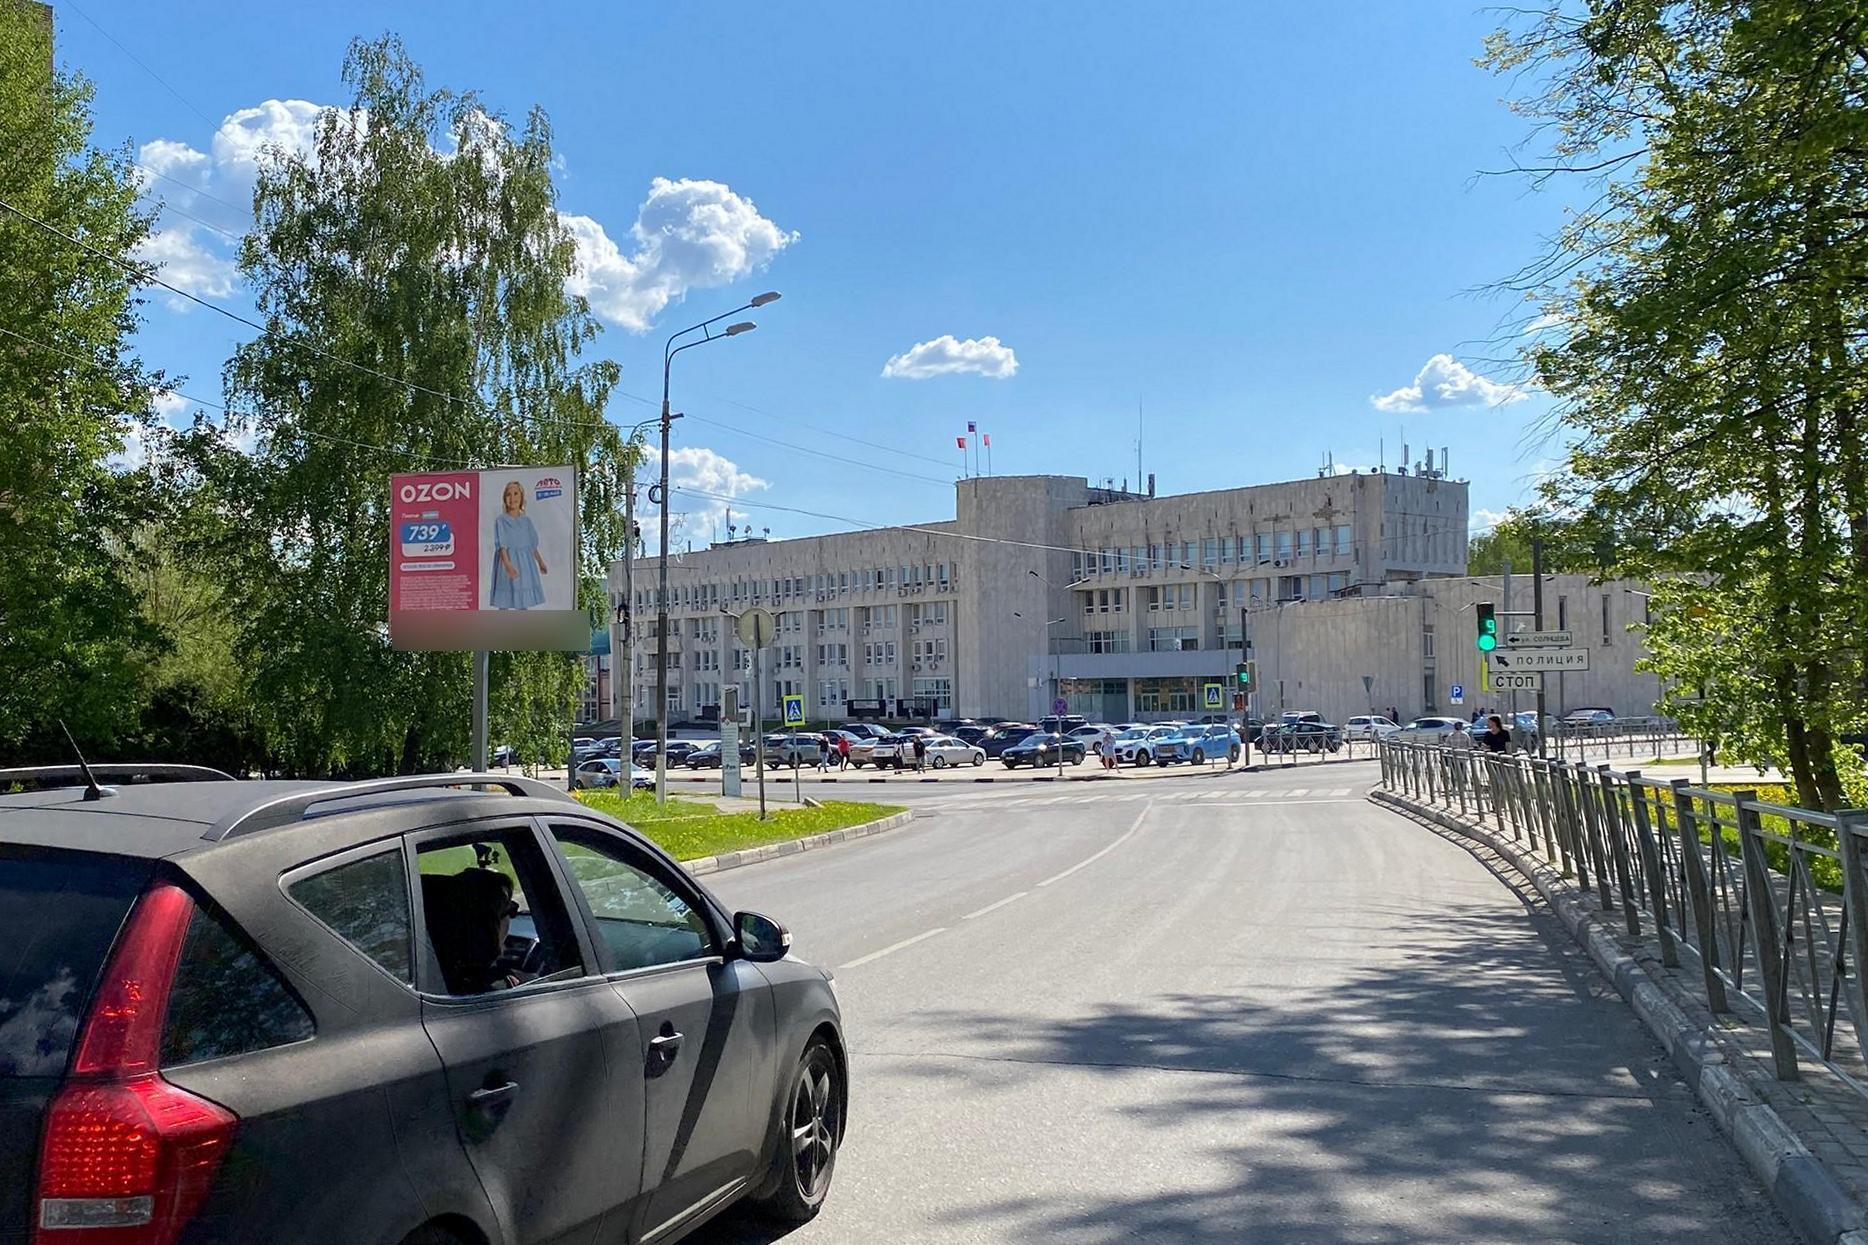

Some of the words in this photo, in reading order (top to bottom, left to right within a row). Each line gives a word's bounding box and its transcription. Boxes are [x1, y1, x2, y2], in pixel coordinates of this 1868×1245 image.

[400, 481, 470, 503] OZON
[408, 525, 439, 541] 739
[1486, 619, 1496, 634] 9
[1516, 655, 1584, 665] ПОЛИЦИЯ
[1495, 676, 1534, 688] СТОП
[1453, 686, 1461, 697] P
